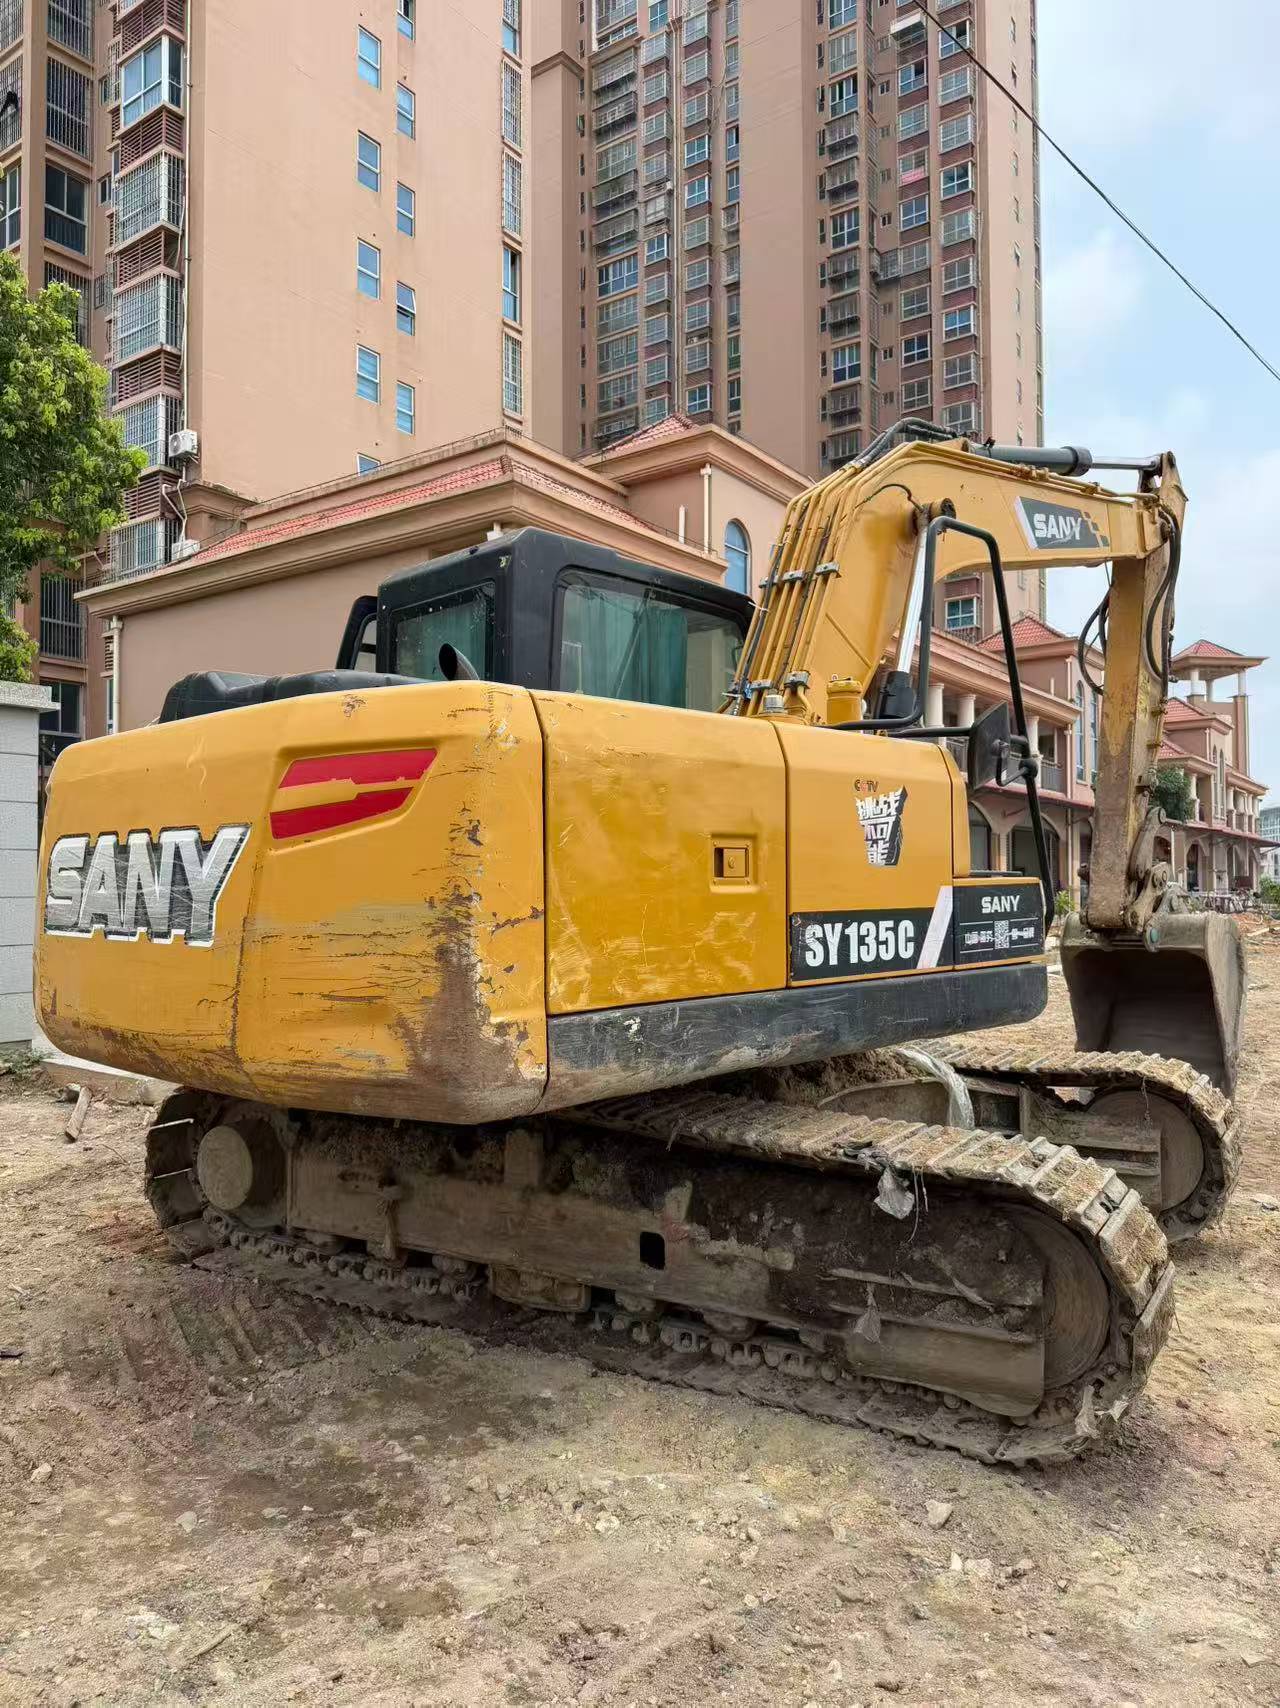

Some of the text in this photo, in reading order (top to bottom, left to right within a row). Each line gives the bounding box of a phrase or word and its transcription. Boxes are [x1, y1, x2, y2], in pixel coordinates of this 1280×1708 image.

[1033, 513, 1082, 540] SANY
[855, 786, 904, 818] 挑战
[867, 841, 889, 866] 能
[45, 824, 252, 947] SANY
[981, 895, 1021, 914] SANY
[805, 920, 915, 967] SY135C
